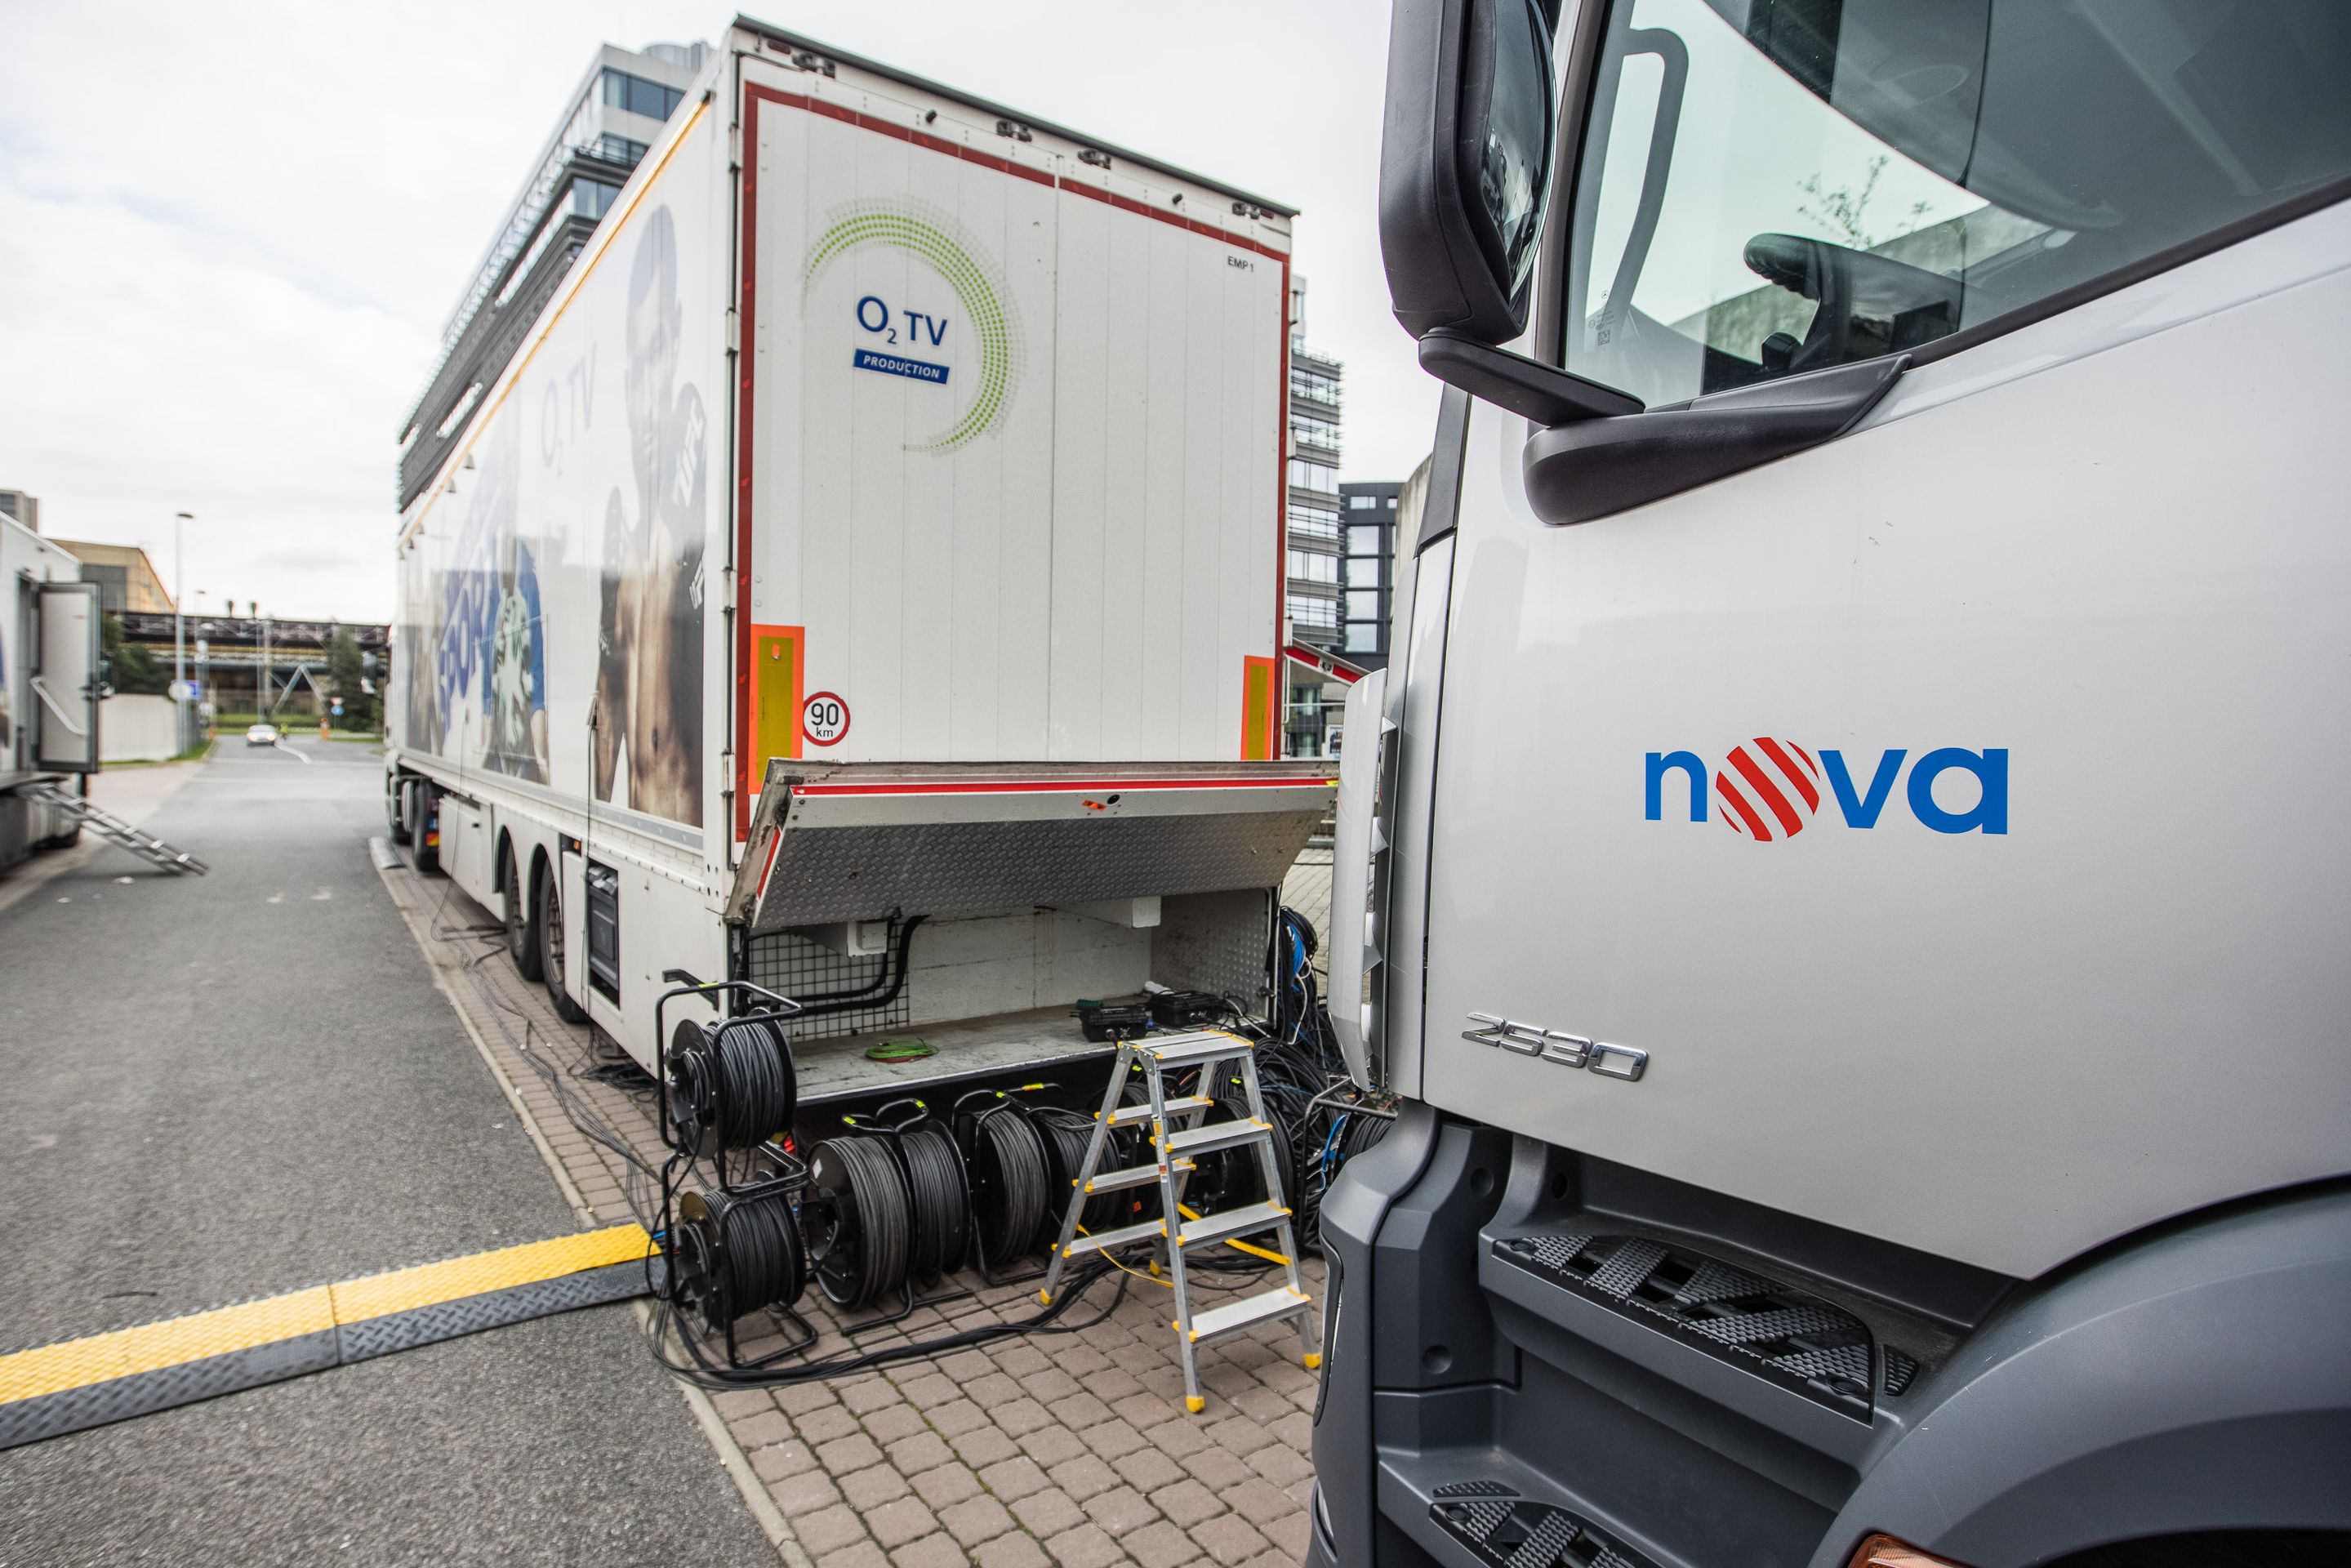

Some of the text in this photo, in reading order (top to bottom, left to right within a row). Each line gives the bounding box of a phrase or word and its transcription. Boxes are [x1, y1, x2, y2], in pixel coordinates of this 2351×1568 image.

[903, 309, 948, 346] TV
[862, 354, 941, 380] PRODUCTION
[677, 396, 703, 508] UFC
[688, 559, 704, 610] UF
[811, 702, 839, 726] 90
[816, 727, 834, 737] km
[1645, 737, 2009, 842] nova
[1461, 1012, 1649, 1082] 2530
